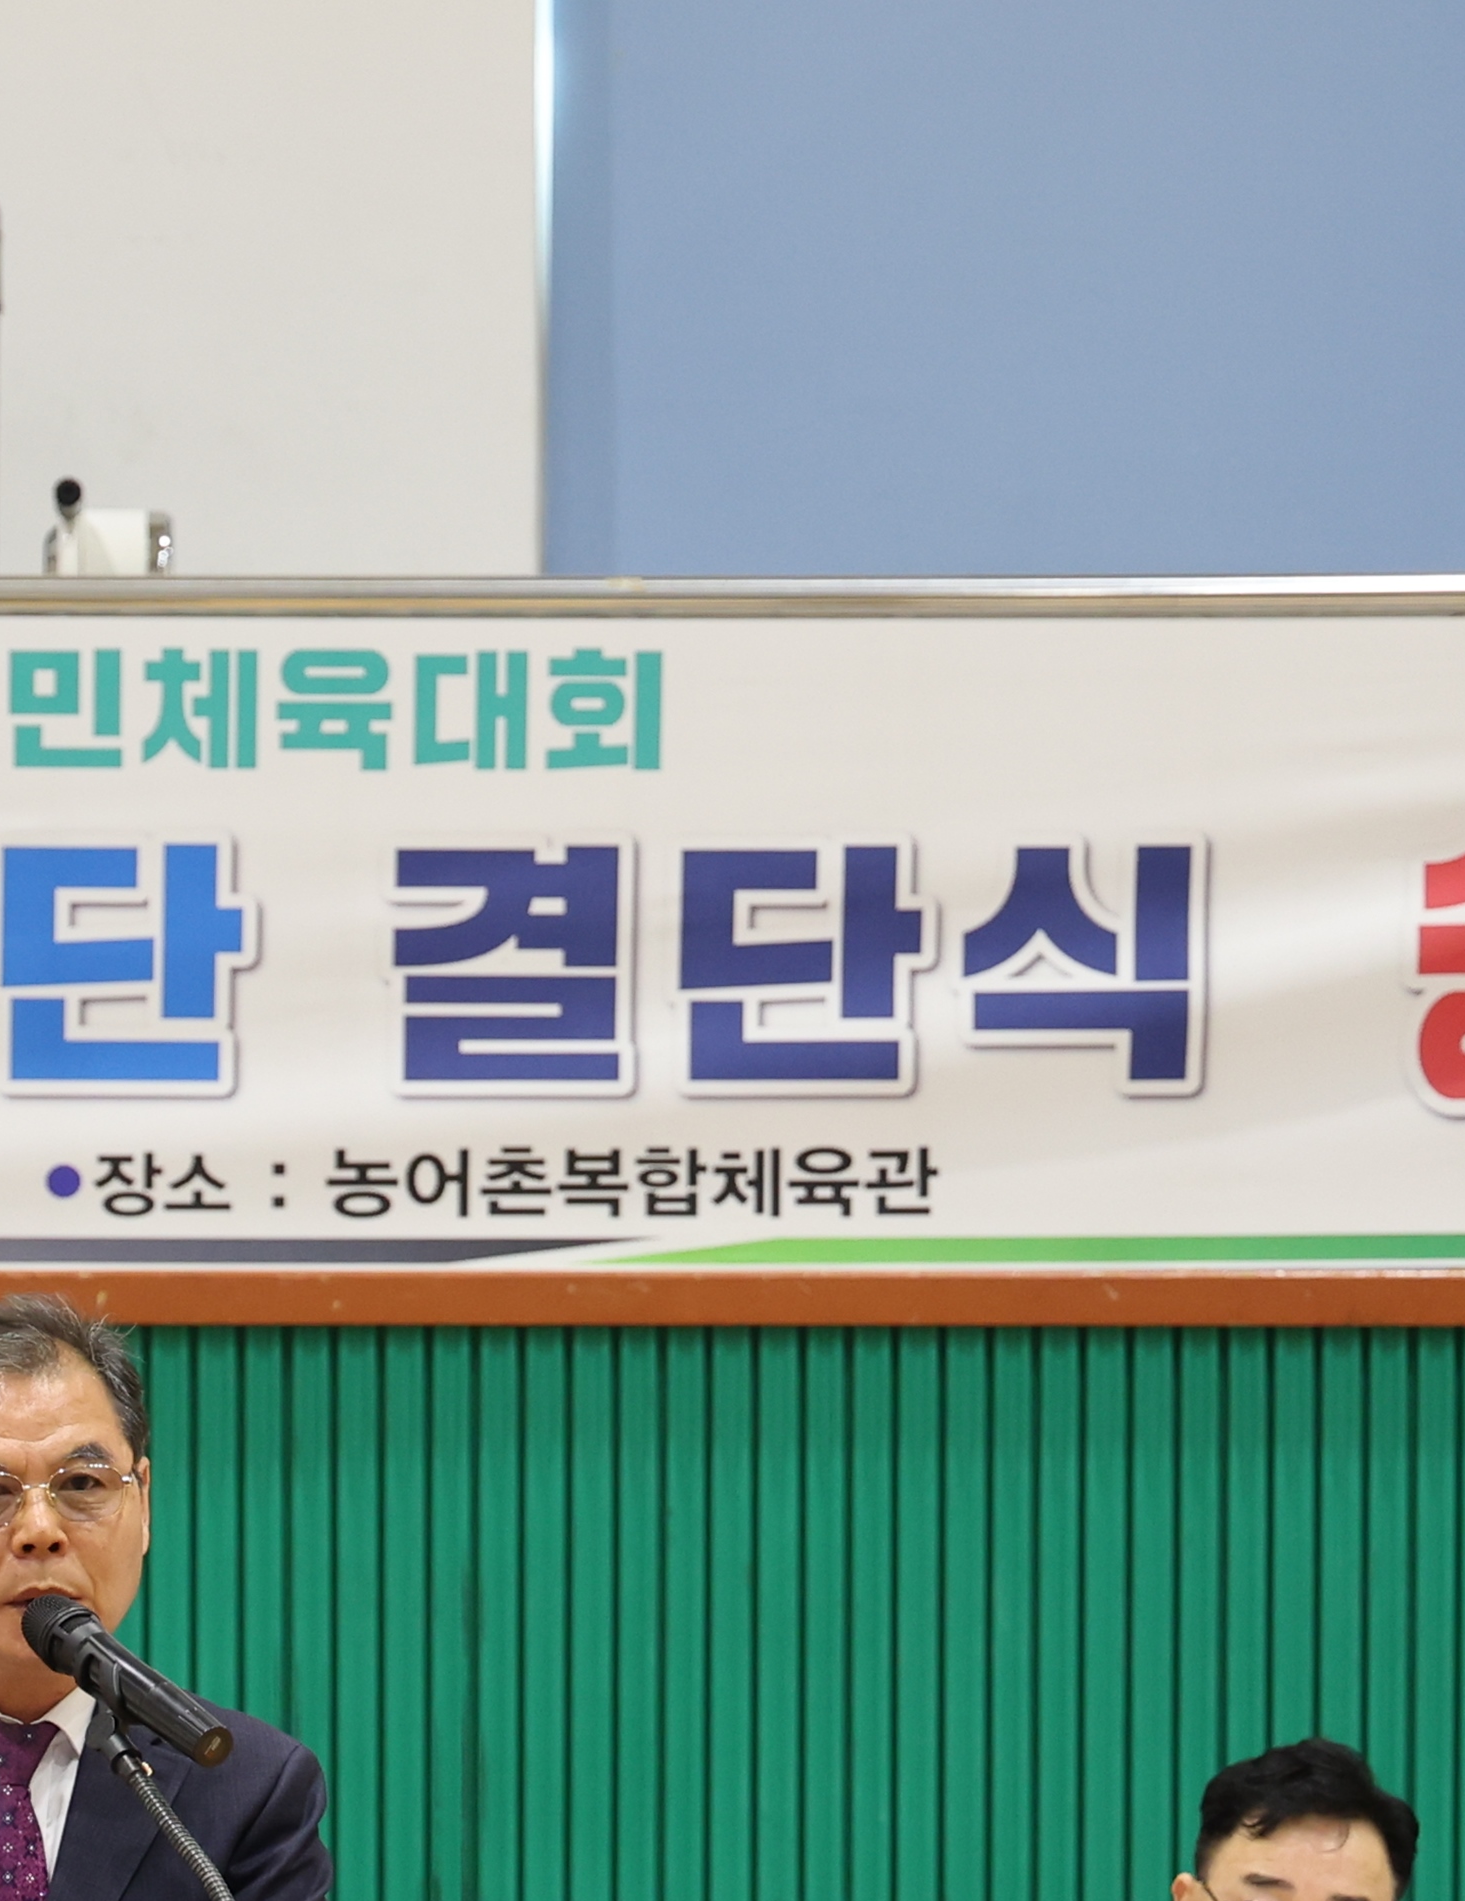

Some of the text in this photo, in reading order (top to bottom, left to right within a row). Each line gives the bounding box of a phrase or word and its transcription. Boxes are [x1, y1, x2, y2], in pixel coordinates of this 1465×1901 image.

[395, 846, 1189, 1082] 결단식
[95, 1152, 231, 1218] 장소
[326, 1147, 939, 1218] 농어촌복합체육관
